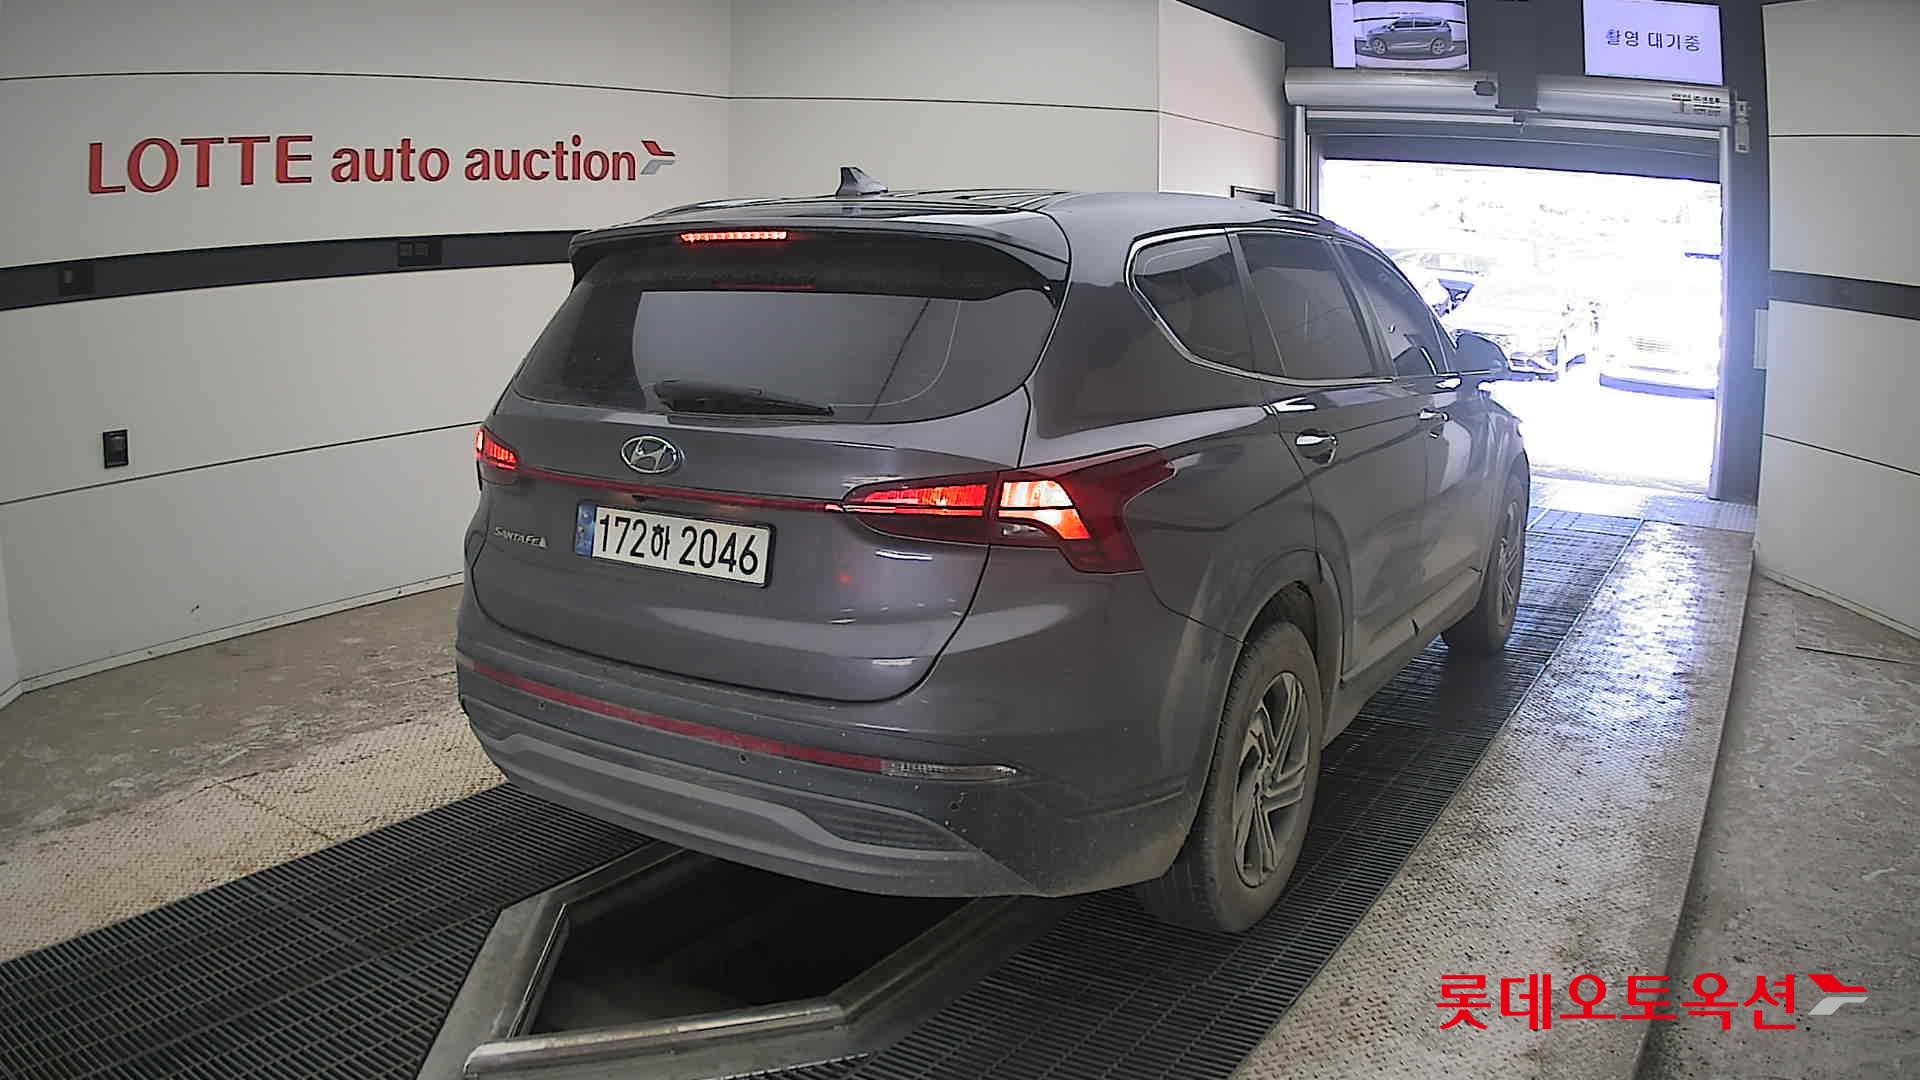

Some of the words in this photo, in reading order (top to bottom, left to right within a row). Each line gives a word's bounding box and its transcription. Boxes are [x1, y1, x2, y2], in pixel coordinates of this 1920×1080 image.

[1606, 29, 1639, 47] 촬영
[1648, 32, 1700, 52] 대기중
[90, 135, 312, 193] LOTTE
[331, 138, 451, 183] auto
[466, 134, 637, 182] auction
[600, 514, 671, 561] 172하
[679, 525, 758, 576] 2046
